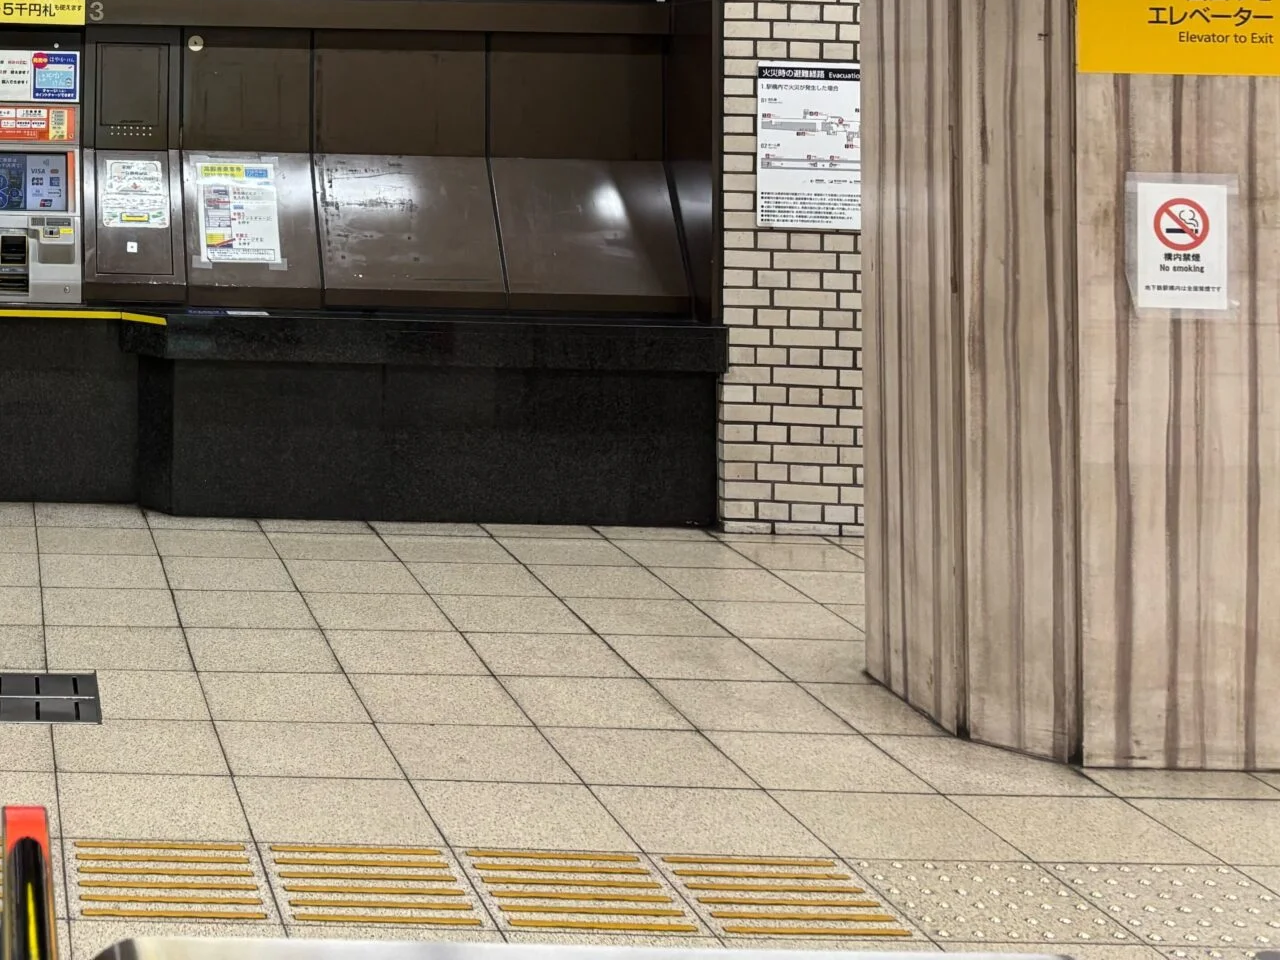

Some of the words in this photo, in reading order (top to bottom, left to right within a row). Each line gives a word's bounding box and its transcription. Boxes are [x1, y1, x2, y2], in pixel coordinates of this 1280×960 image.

[89, 1, 104, 21] 3
[1148, 6, 1274, 27] エレベーター
[1178, 31, 1230, 44] Elevator
[1234, 33, 1247, 44] to
[1251, 32, 1274, 45] Exit
[762, 68, 825, 79] 火災時の避難経路
[1164, 253, 1200, 262] 構内禁煙
[1173, 264, 1204, 273] smoking
